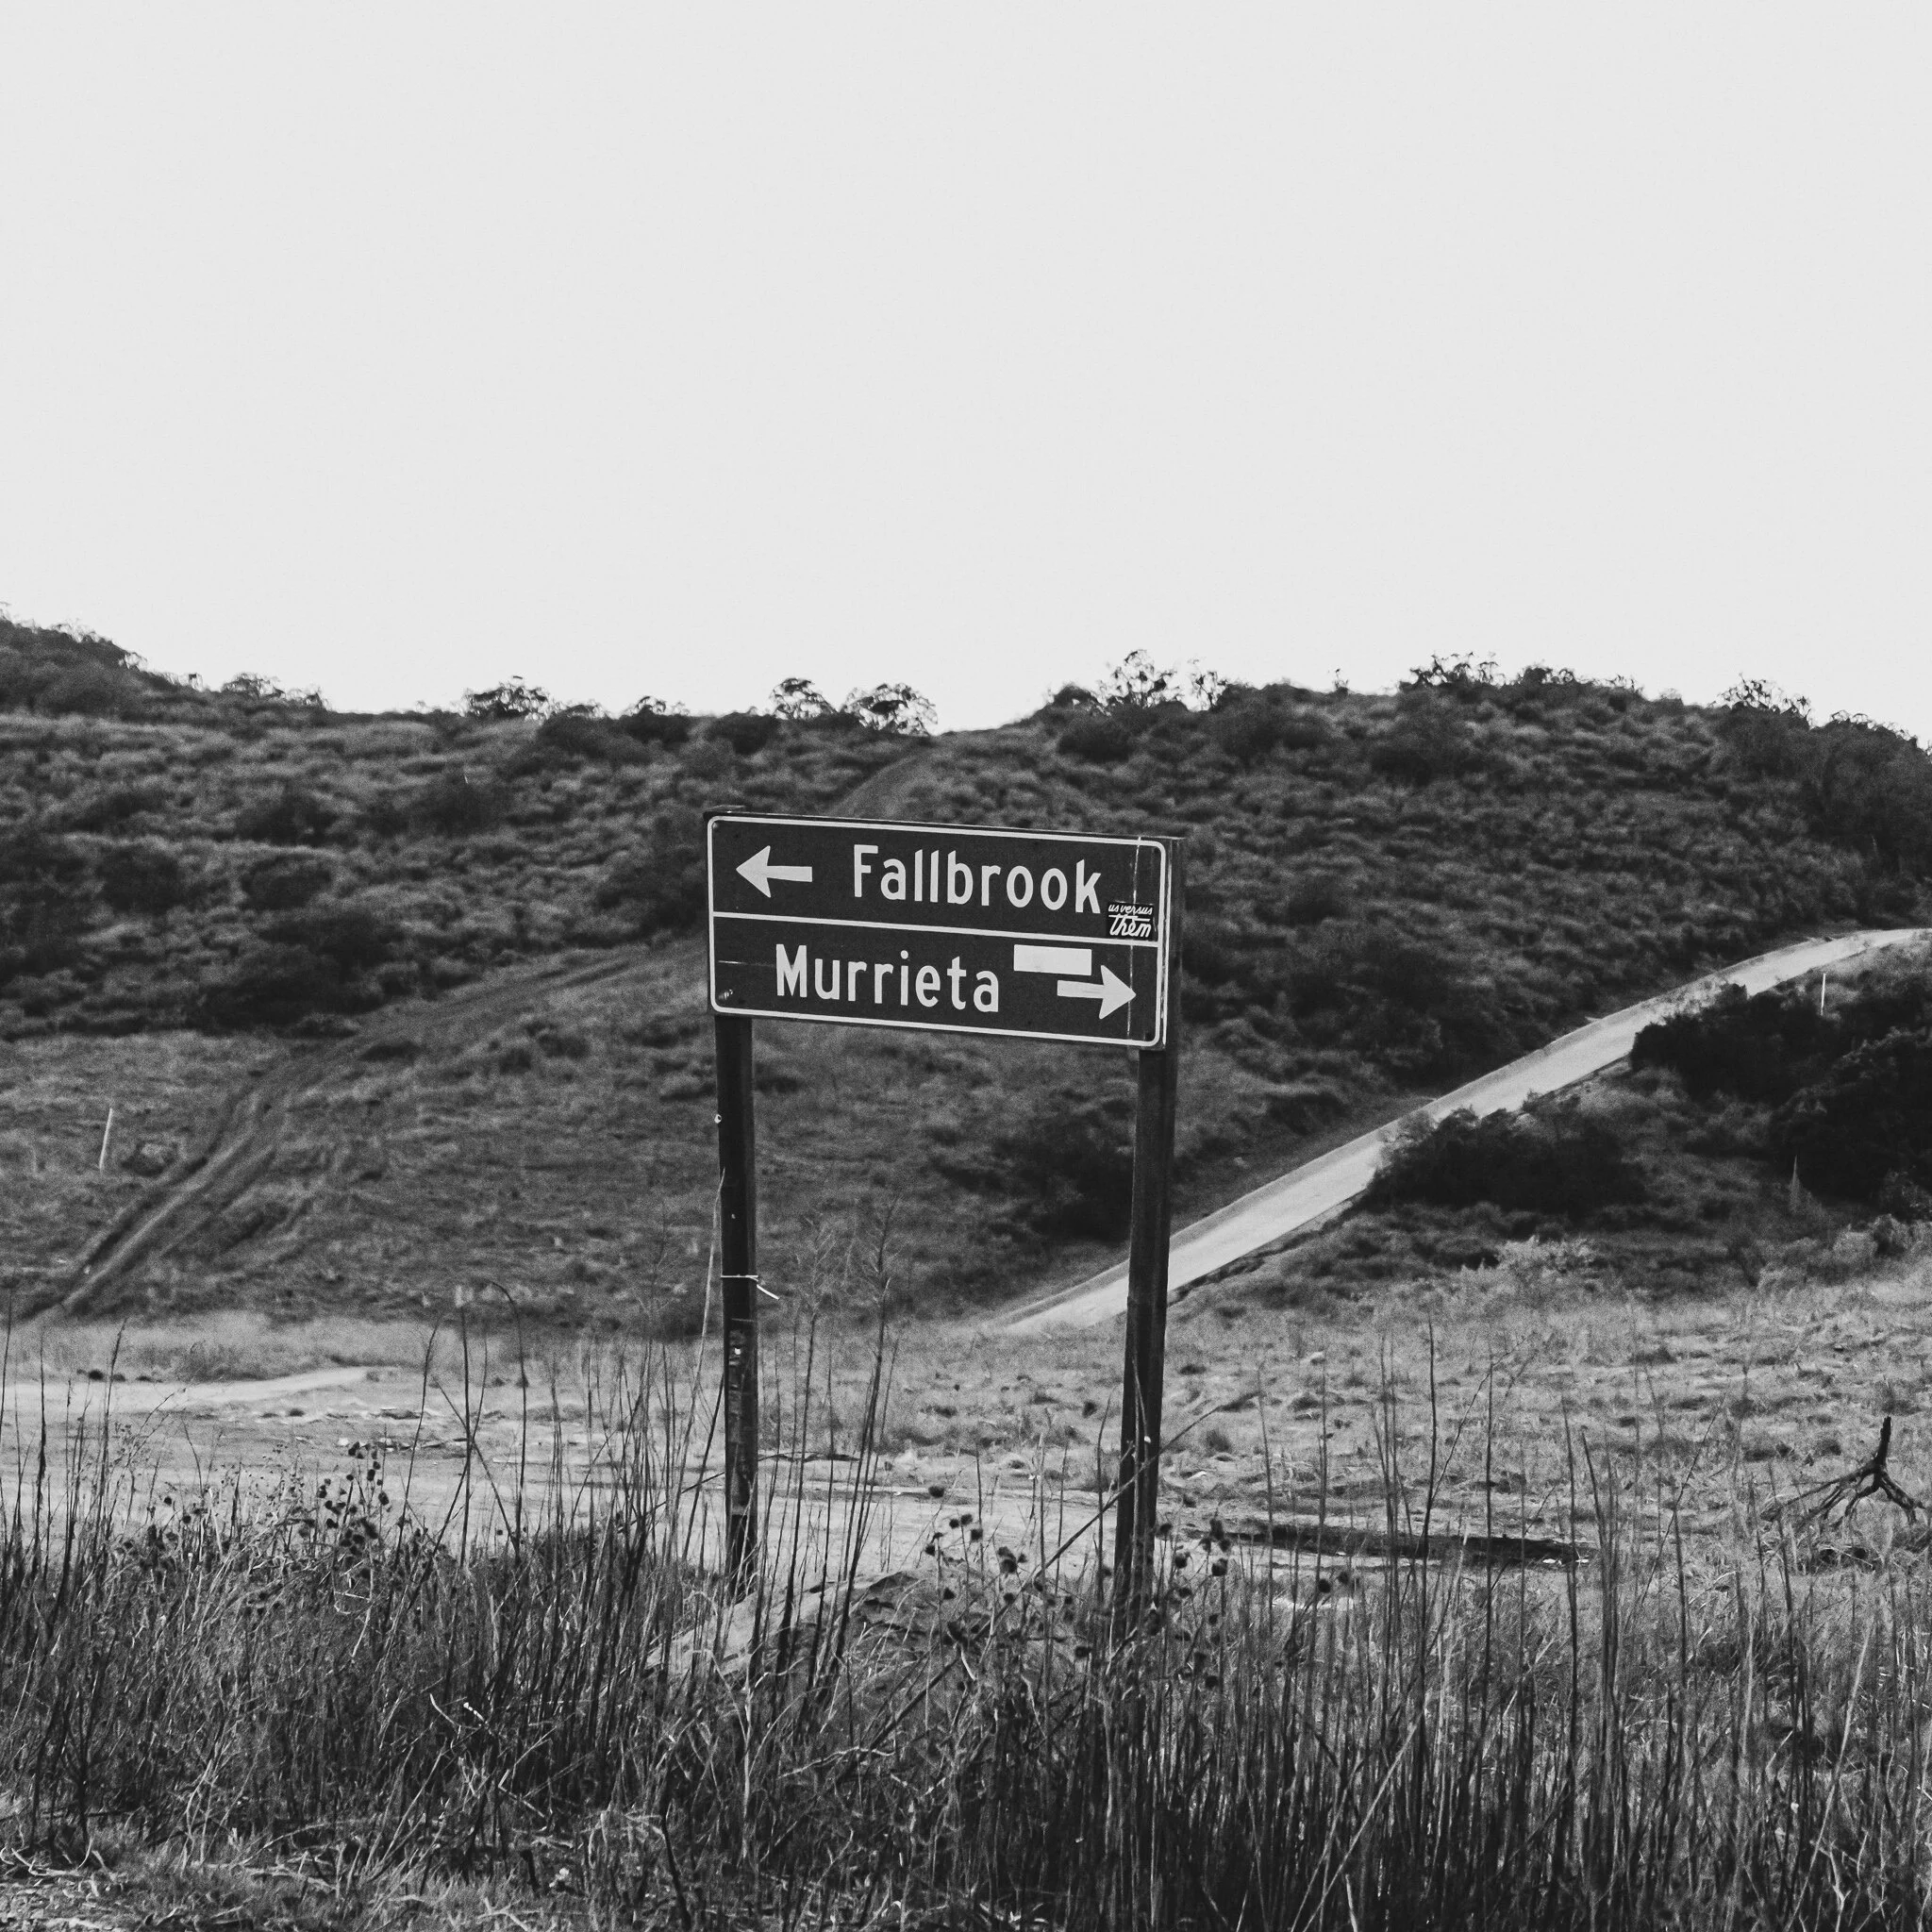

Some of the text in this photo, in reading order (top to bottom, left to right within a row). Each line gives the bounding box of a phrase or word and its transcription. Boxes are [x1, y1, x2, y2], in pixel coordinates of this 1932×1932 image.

[854, 844, 1101, 913] Fallbrook
[1108, 904, 1153, 915] us versus
[775, 943, 999, 1012] Murrieta
